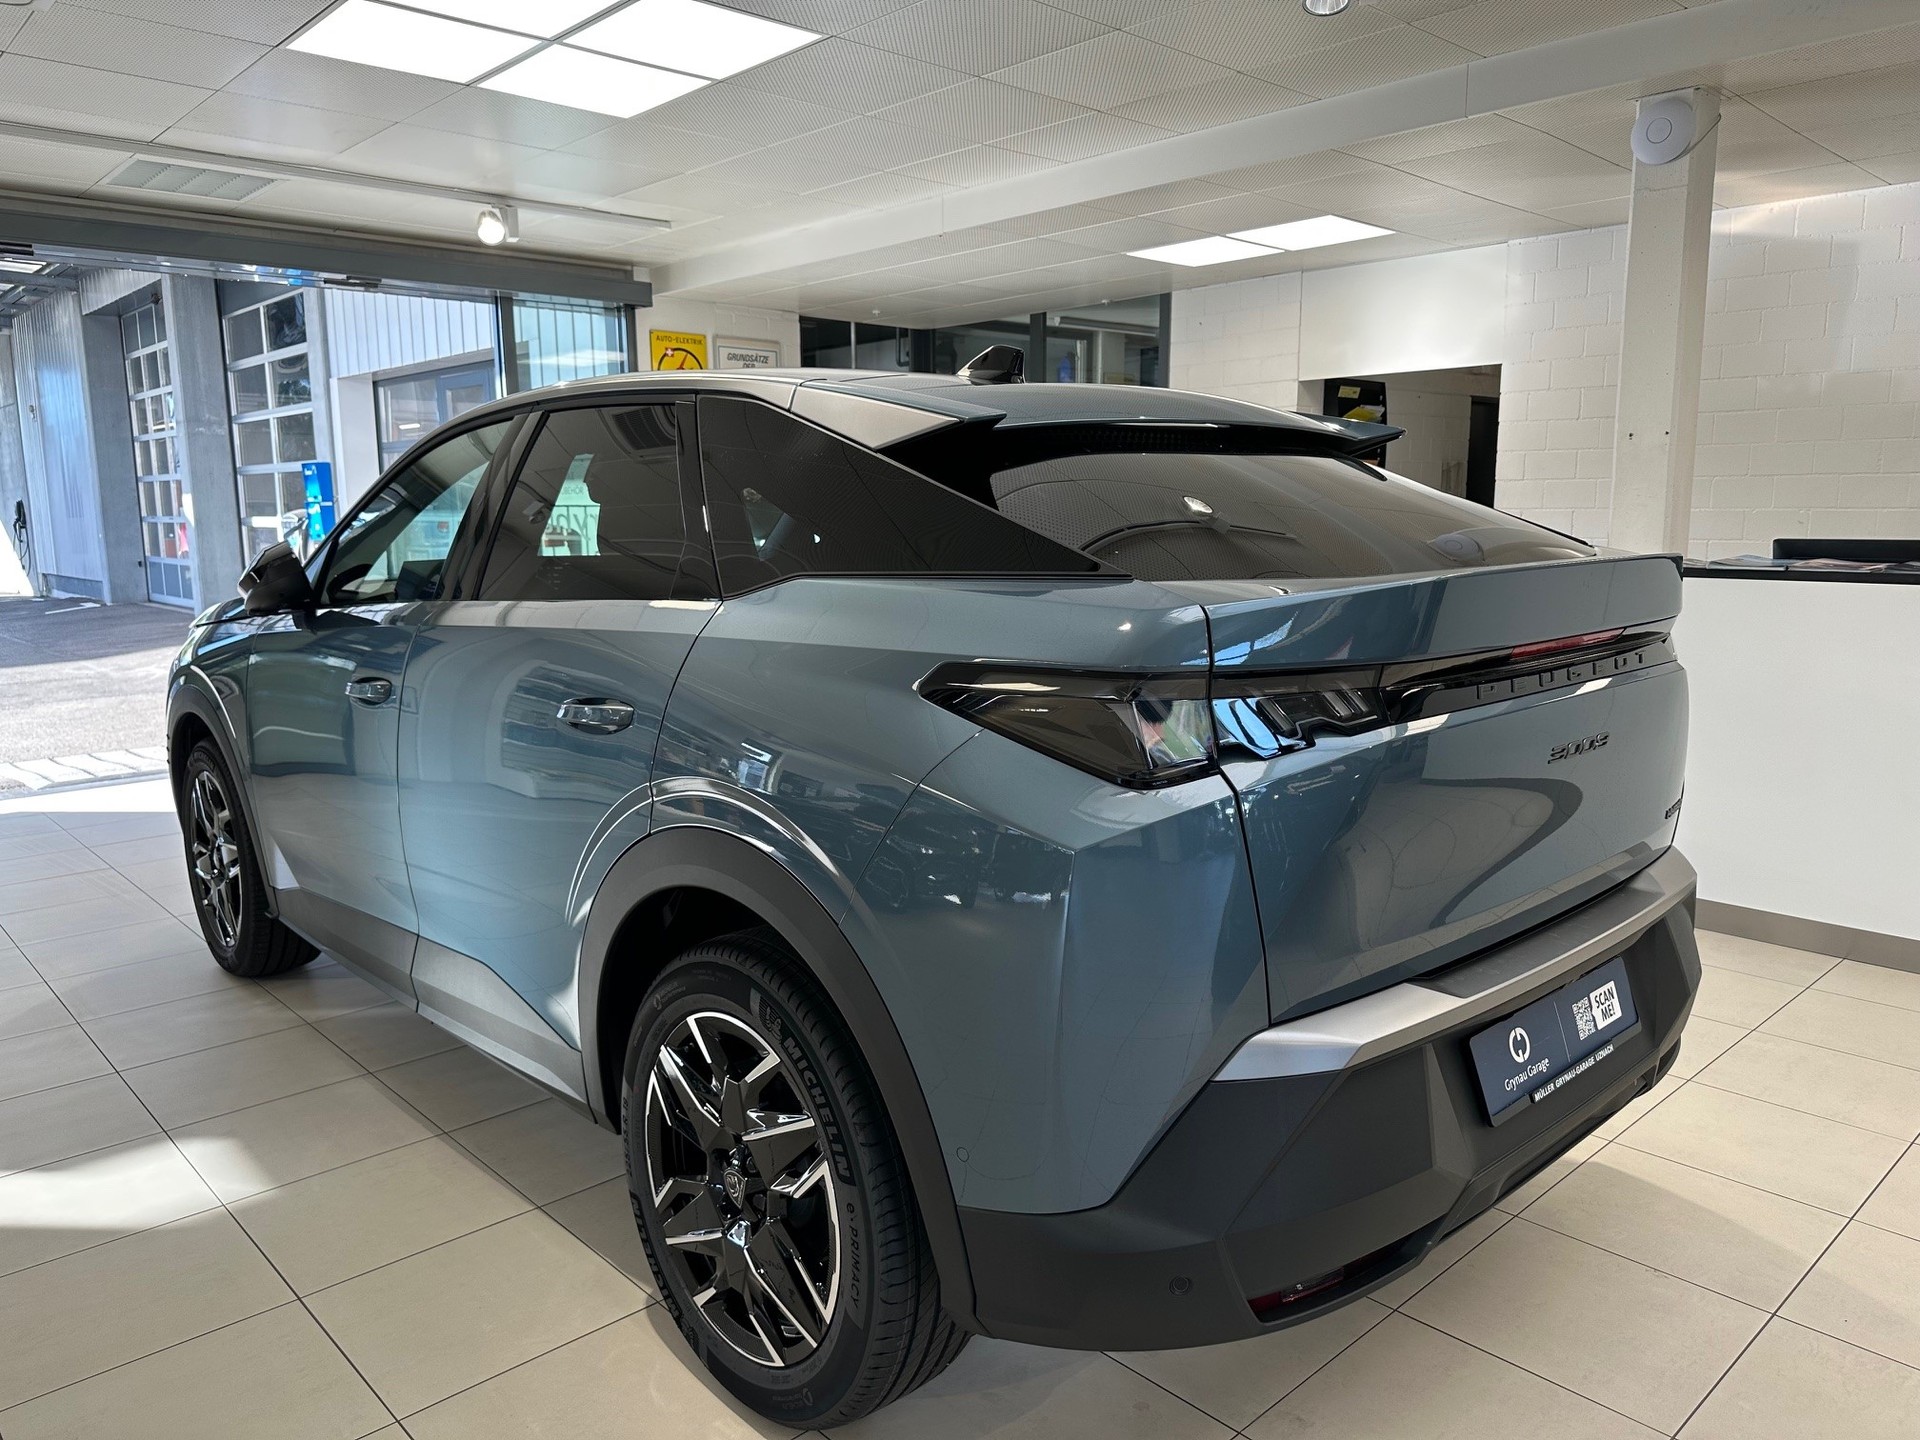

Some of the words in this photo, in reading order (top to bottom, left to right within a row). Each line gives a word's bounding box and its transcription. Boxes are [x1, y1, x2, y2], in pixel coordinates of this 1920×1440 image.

[656, 335, 703, 345] AUTO-ELEKTRIK
[726, 352, 770, 364] GRUNDSÄTZE
[1476, 651, 1646, 699] PEUGEOT
[1547, 731, 1610, 764] 3008
[1594, 986, 1615, 1009] SCAN
[1601, 1004, 1616, 1022] ME!
[1504, 1069, 1528, 1092] Grynau
[1527, 1057, 1550, 1077] Garage
[1534, 1082, 1556, 1102] MÜLLER
[1555, 1057, 1596, 1088] GRYNAU-GARAGE
[1595, 1044, 1615, 1061] UZNACH
[783, 1036, 851, 1177] MICHELIN
